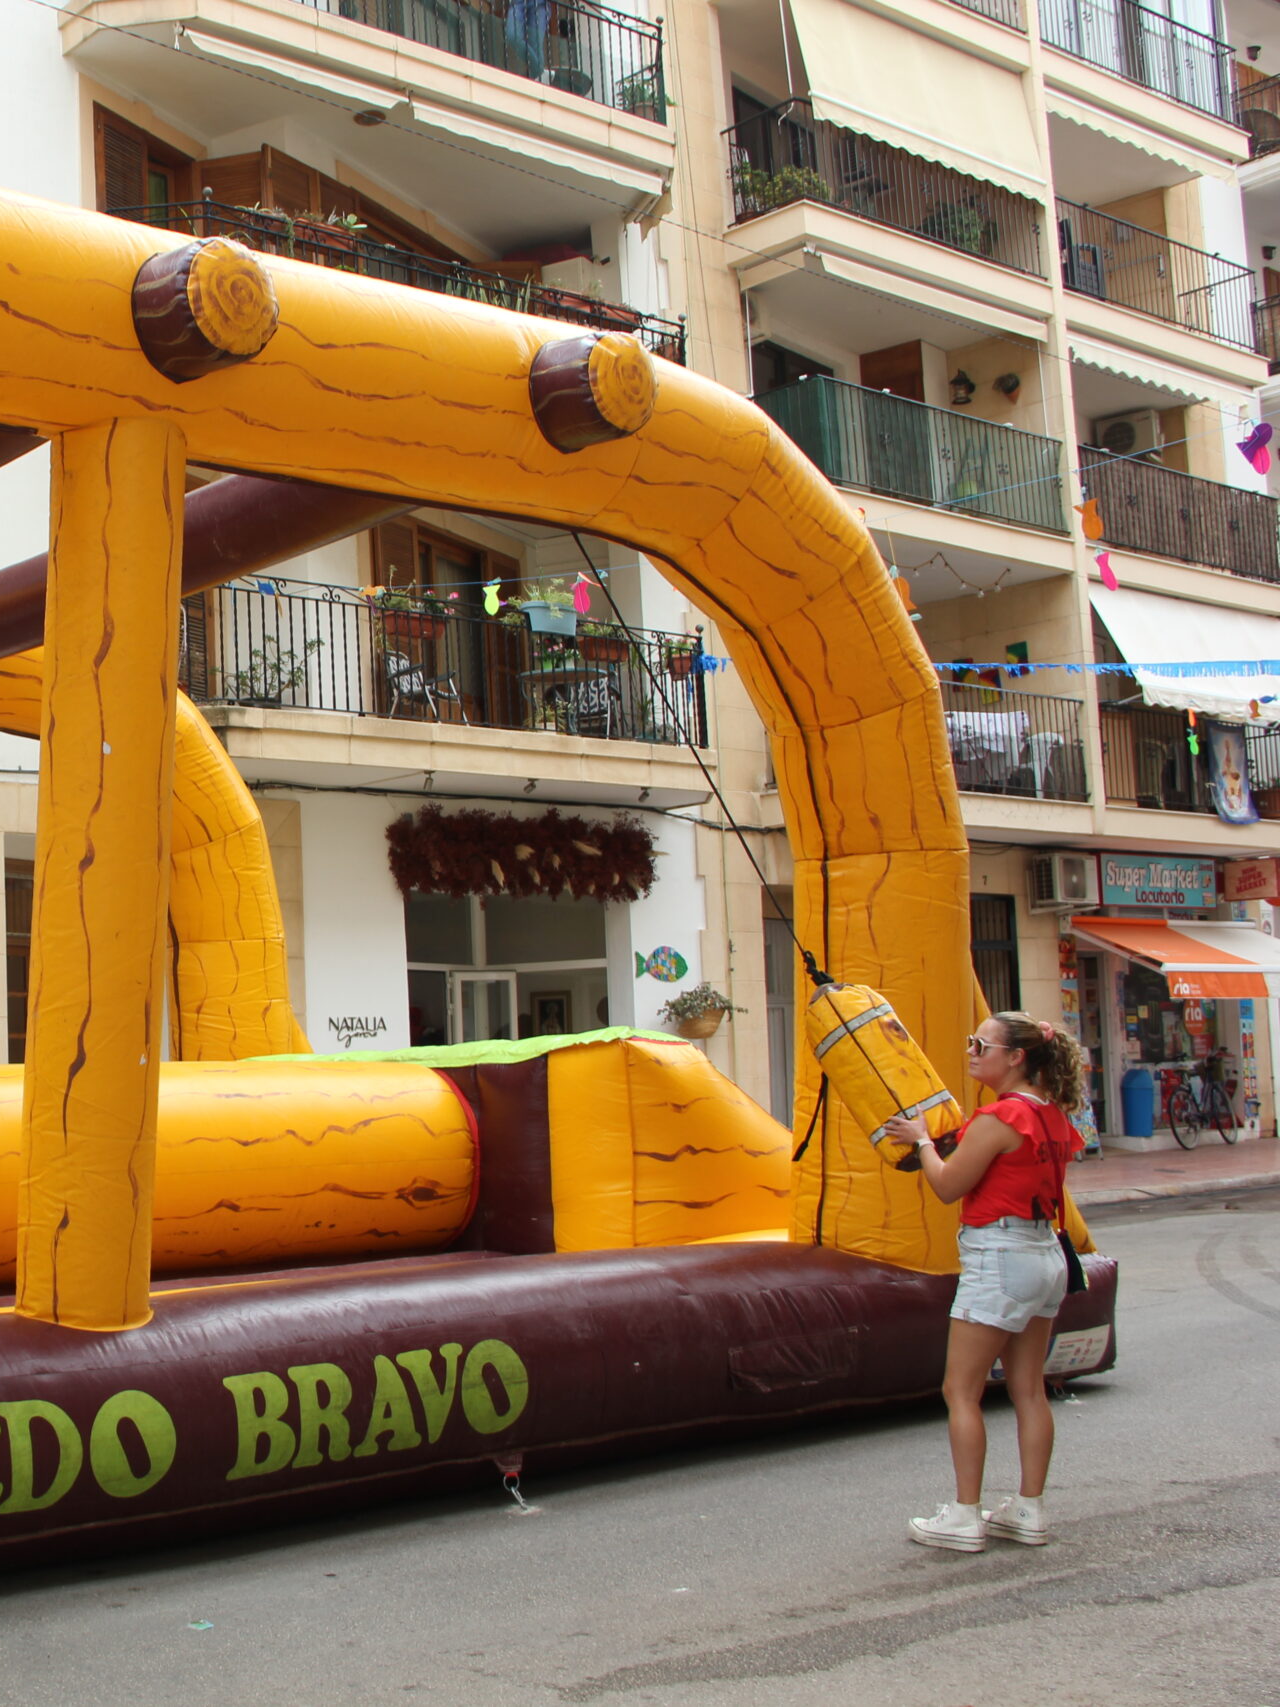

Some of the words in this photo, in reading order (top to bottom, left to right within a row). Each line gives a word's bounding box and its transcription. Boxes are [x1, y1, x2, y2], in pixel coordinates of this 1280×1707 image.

[1106, 861, 1146, 892] Super
[1148, 862, 1198, 889] Market
[1135, 888, 1185, 905] Locutorio
[1173, 977, 1190, 994] ria
[1185, 1000, 1202, 1021] ria
[328, 1016, 387, 1032] NATALIA
[223, 1339, 529, 1482] BRAVO
